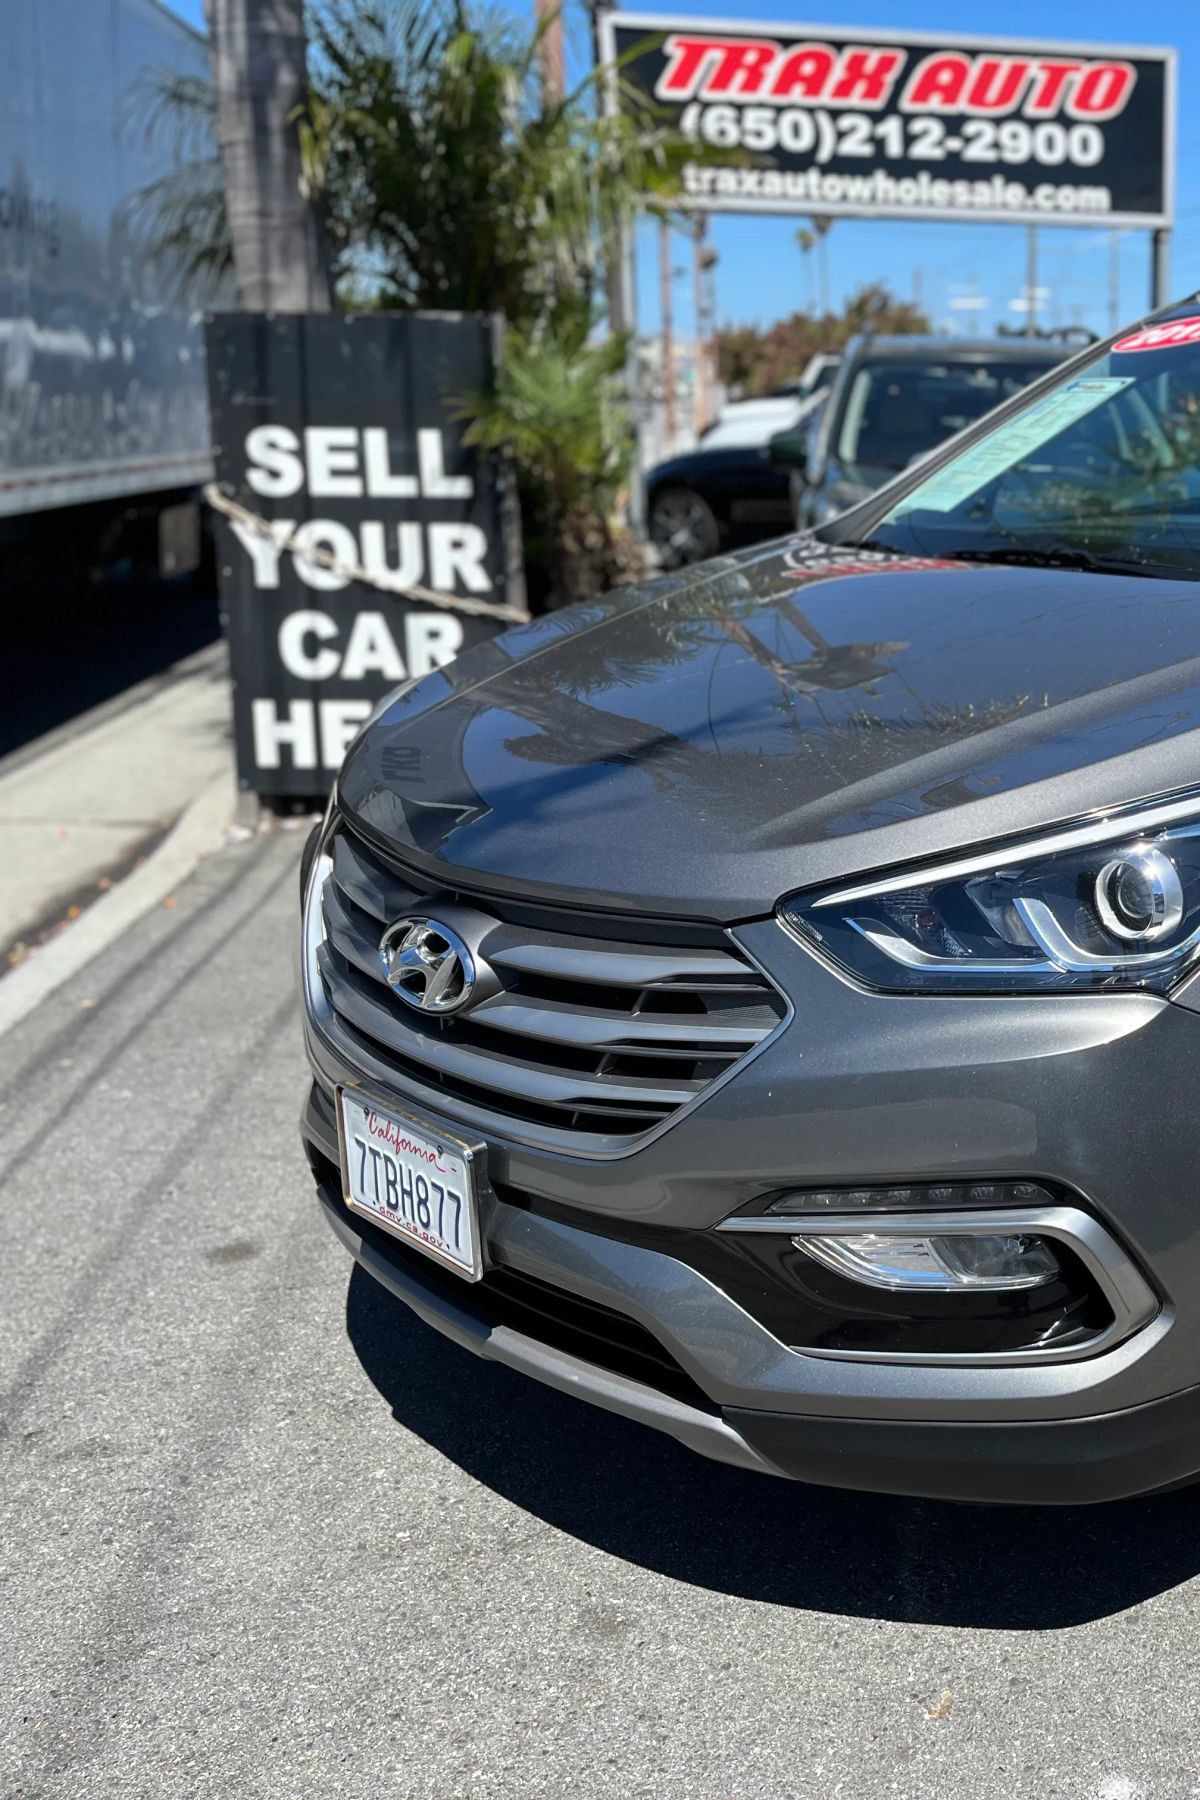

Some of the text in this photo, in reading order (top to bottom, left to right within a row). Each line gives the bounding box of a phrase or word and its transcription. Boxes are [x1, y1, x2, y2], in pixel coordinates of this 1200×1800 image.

[654, 33, 1137, 121] TRAX AUTO
[680, 102, 1103, 167] (650)212-2900
[683, 163, 1111, 212] traxautowholesale.com
[245, 424, 473, 499] SELL
[229, 518, 492, 593] YOUR
[277, 609, 464, 682] CAR
[250, 697, 374, 770] HE
[368, 1110, 446, 1174] California
[354, 1136, 462, 1250] 7TBH877
